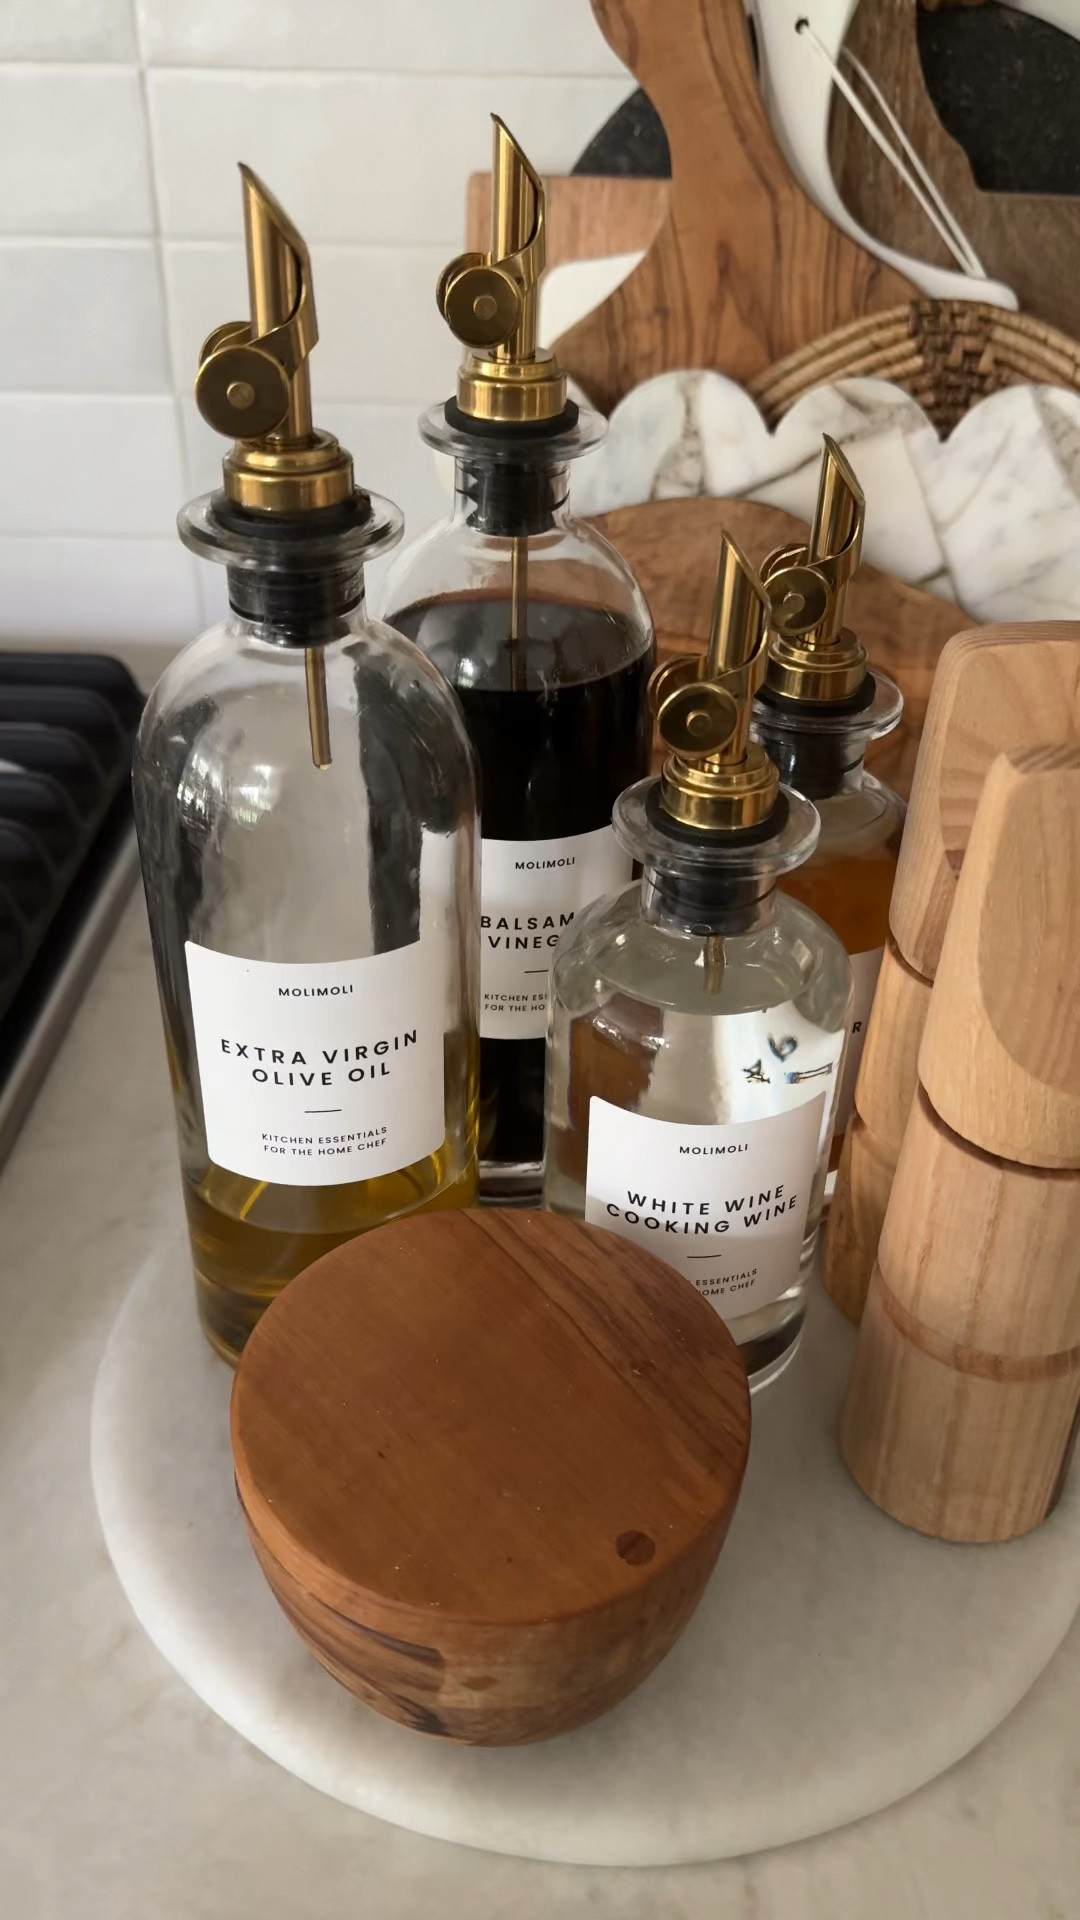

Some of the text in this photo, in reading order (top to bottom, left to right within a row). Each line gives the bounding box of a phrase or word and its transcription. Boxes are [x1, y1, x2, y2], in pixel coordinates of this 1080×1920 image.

[516, 857, 575, 870] MOLIMOLI
[480, 912, 575, 930] BALSAM
[488, 935, 559, 949] VINEG
[278, 984, 354, 997] MOLIMOLI
[484, 993, 529, 1002] KITCHEN
[484, 1003, 504, 1012] FOR
[221, 1029, 417, 1064] EXTRA VIRGIN
[252, 1062, 390, 1086] OLIVE OIL
[261, 1126, 388, 1144] KITCHEN ESSENTIALS
[264, 1137, 388, 1156] FOR THE HOME CHEF
[679, 1143, 748, 1155] MOLIMOLI
[627, 1184, 785, 1216] WHITE WINE
[606, 1195, 798, 1235] COOKING WINE
[695, 1268, 758, 1286] ESSENTIALS
[697, 1279, 756, 1296] OME CHEF
